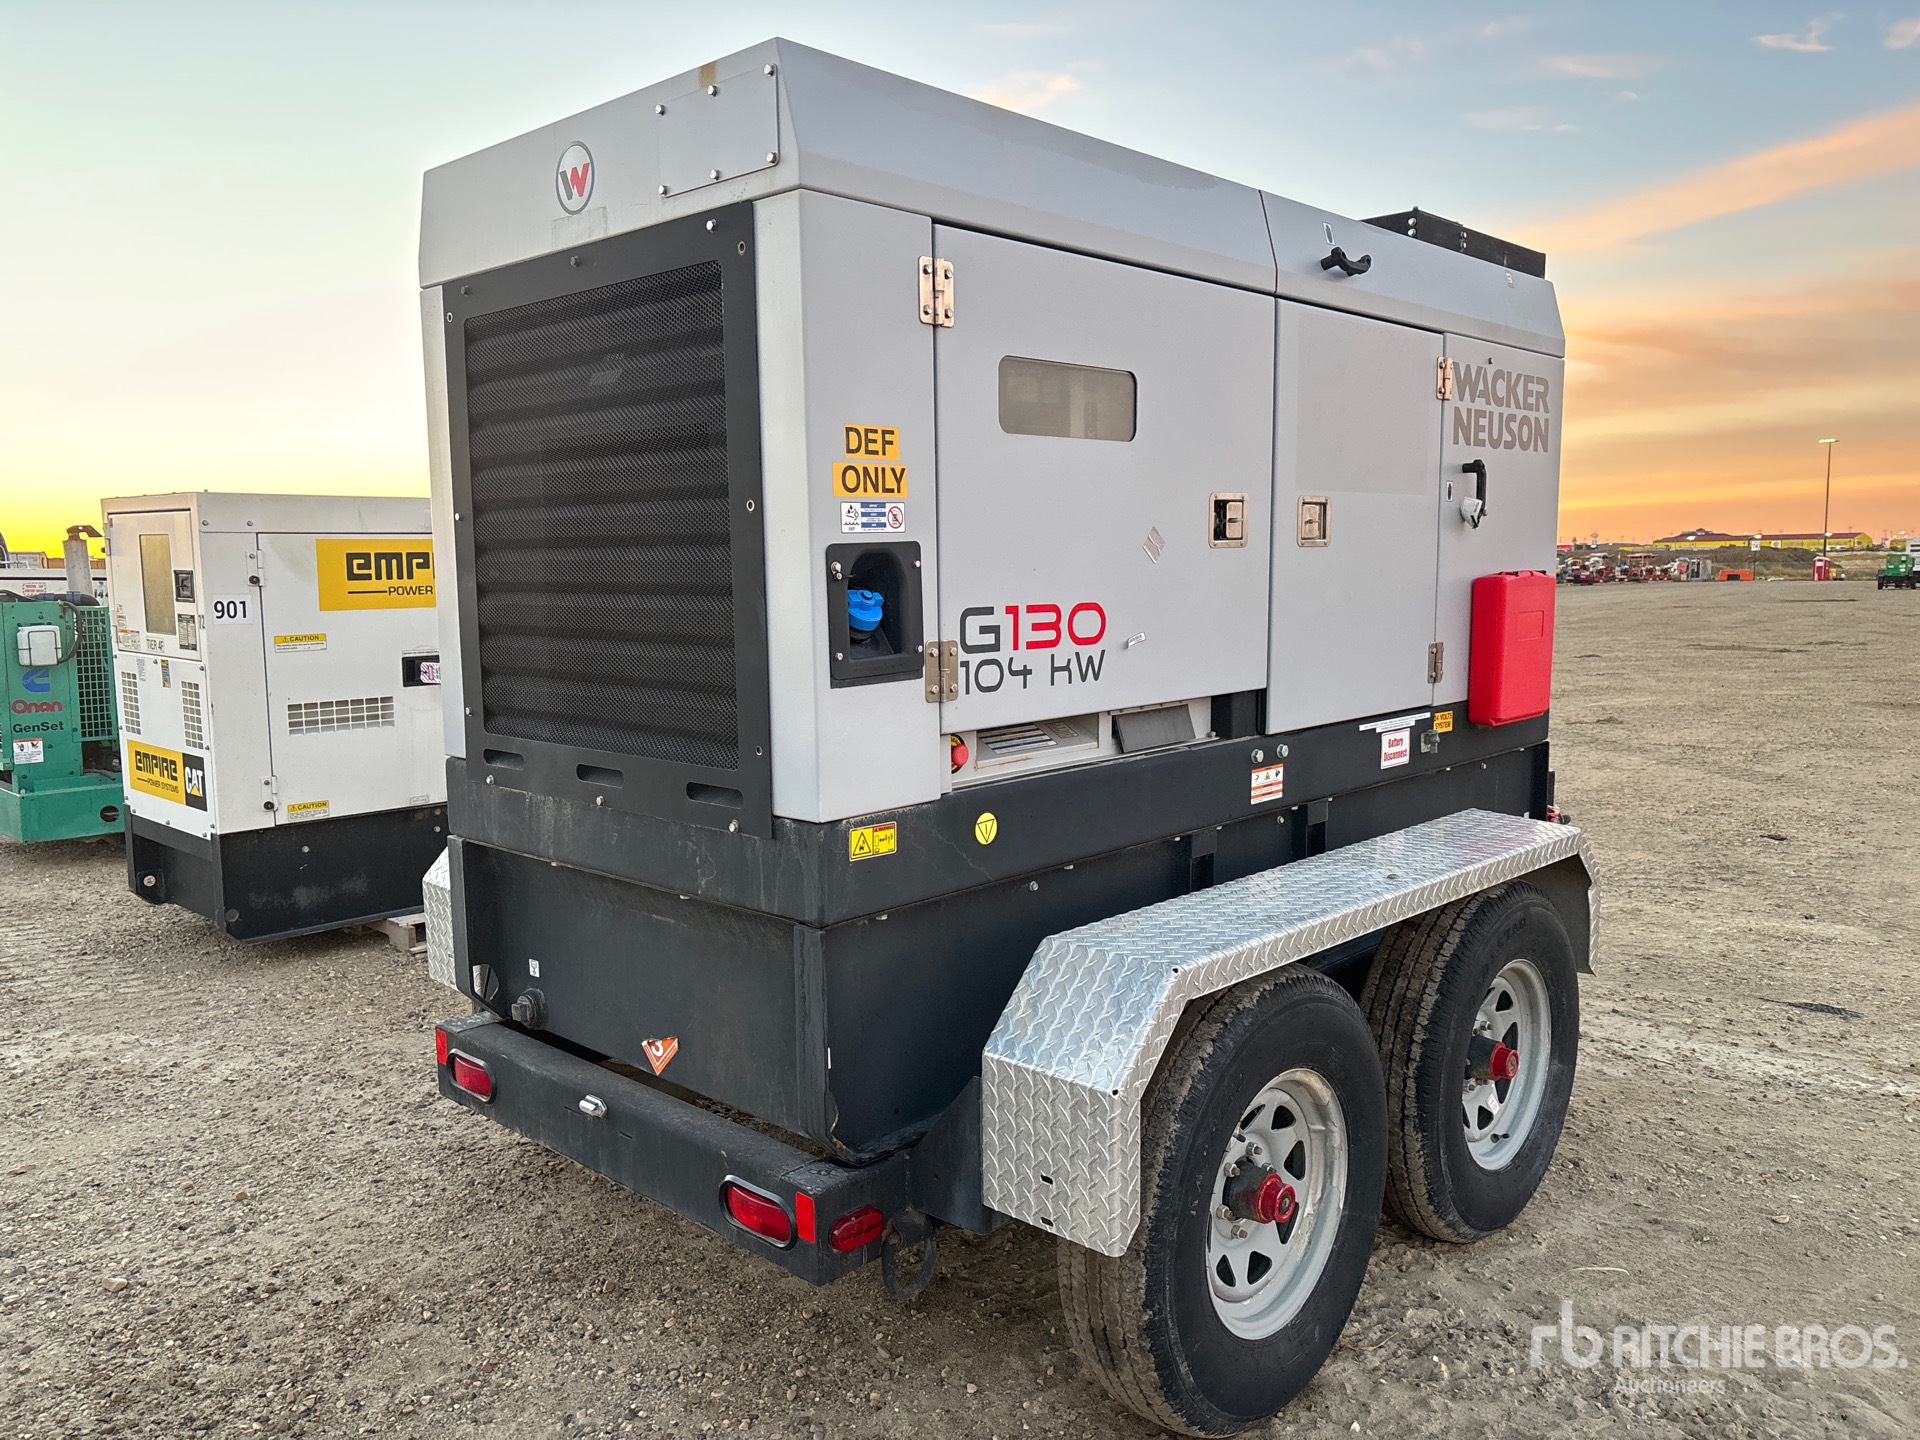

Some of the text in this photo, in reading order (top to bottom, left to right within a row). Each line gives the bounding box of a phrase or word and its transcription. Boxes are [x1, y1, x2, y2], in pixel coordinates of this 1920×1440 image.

[1453, 361, 1549, 413] WACKER
[845, 427, 895, 456] DEF
[1453, 406, 1549, 452] NEUSON
[841, 465, 906, 494] ONLY
[346, 552, 435, 581] EMP
[388, 586, 434, 596] POWER
[214, 600, 246, 619] 901
[959, 602, 1106, 654] G130
[960, 657, 1033, 695] 104
[12, 700, 63, 714] Onan
[13, 721, 64, 733] GenSet
[1435, 721, 1451, 730] SYSTEM
[1384, 749, 1407, 761] Disconnect
[1388, 738, 1404, 748] Battery
[134, 750, 178, 782] EMPIRE
[184, 766, 204, 797] CAT
[298, 802, 326, 810] CAUTION
